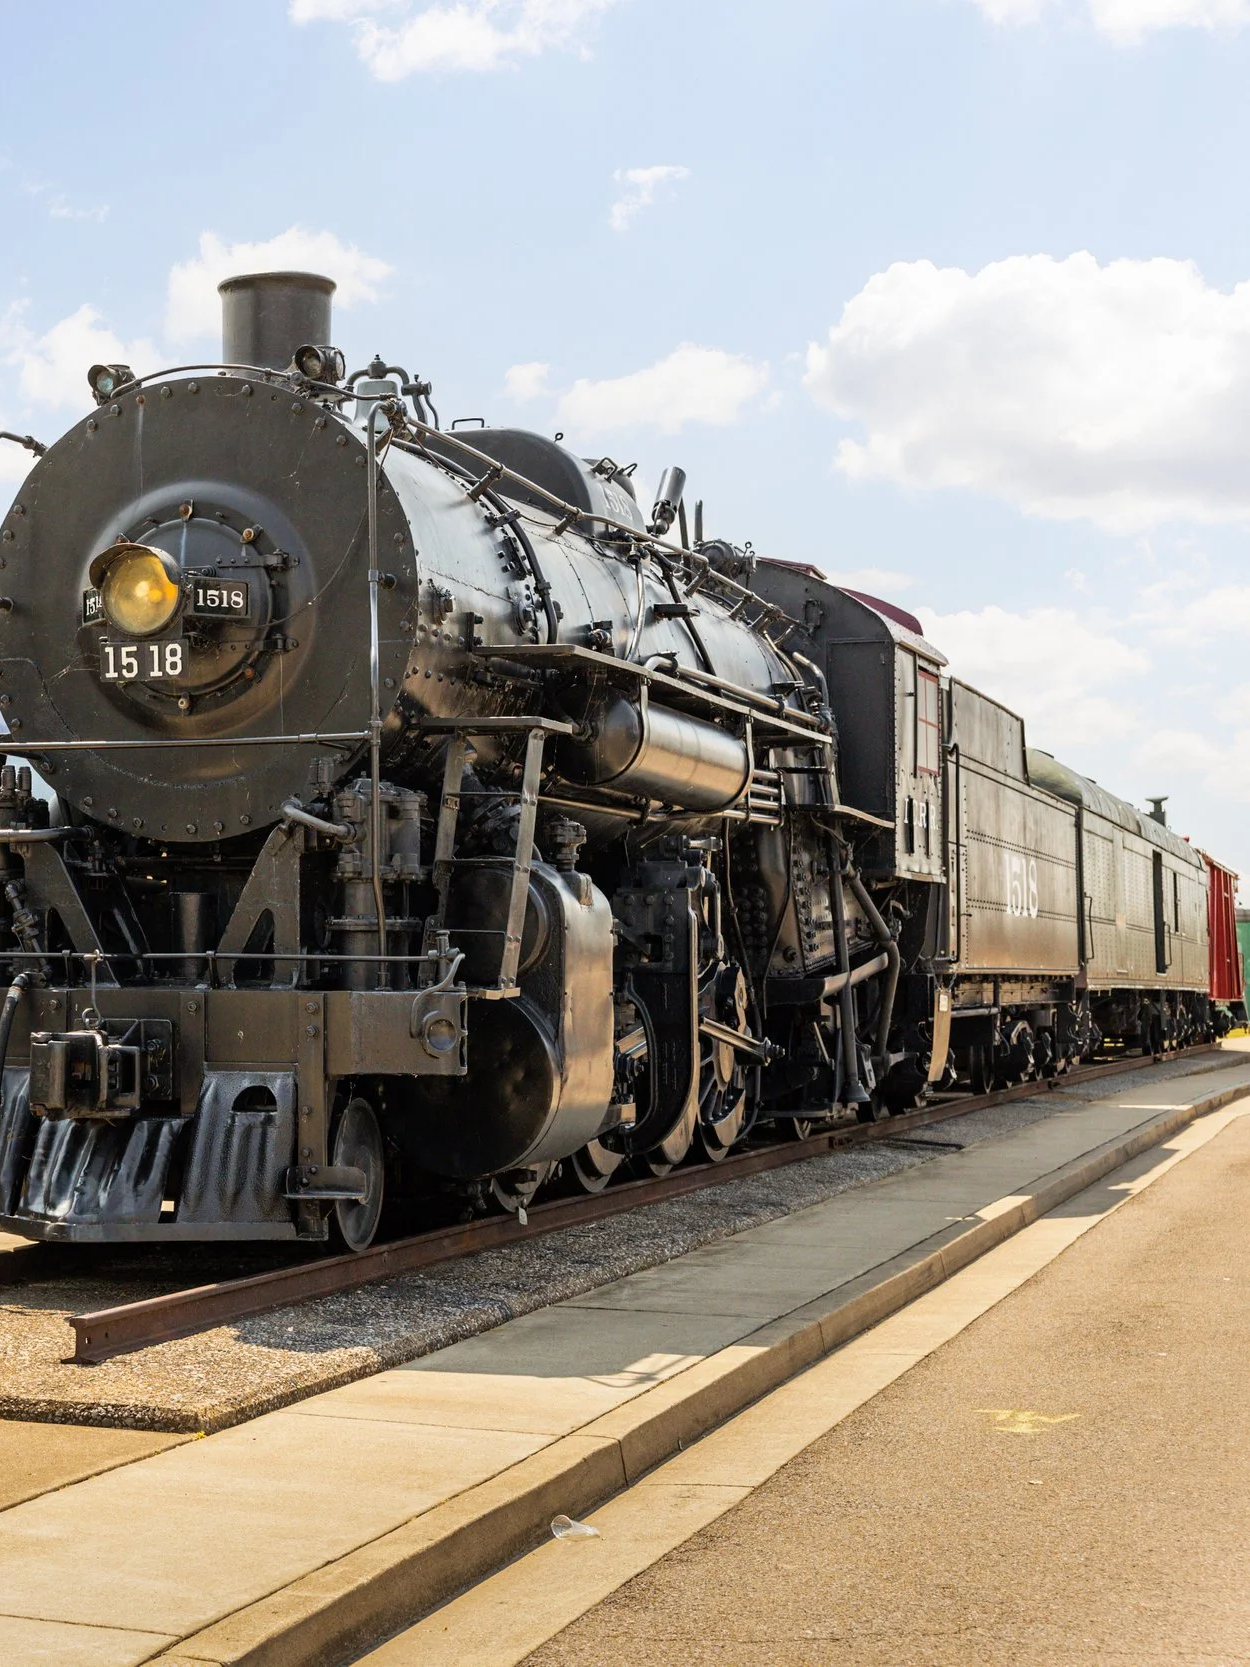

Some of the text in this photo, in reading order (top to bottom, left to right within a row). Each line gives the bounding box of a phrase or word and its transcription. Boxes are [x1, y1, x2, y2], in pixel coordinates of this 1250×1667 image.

[86, 595, 103, 616] 151
[196, 588, 244, 609] 1518
[1004, 853, 1039, 919] 1518
